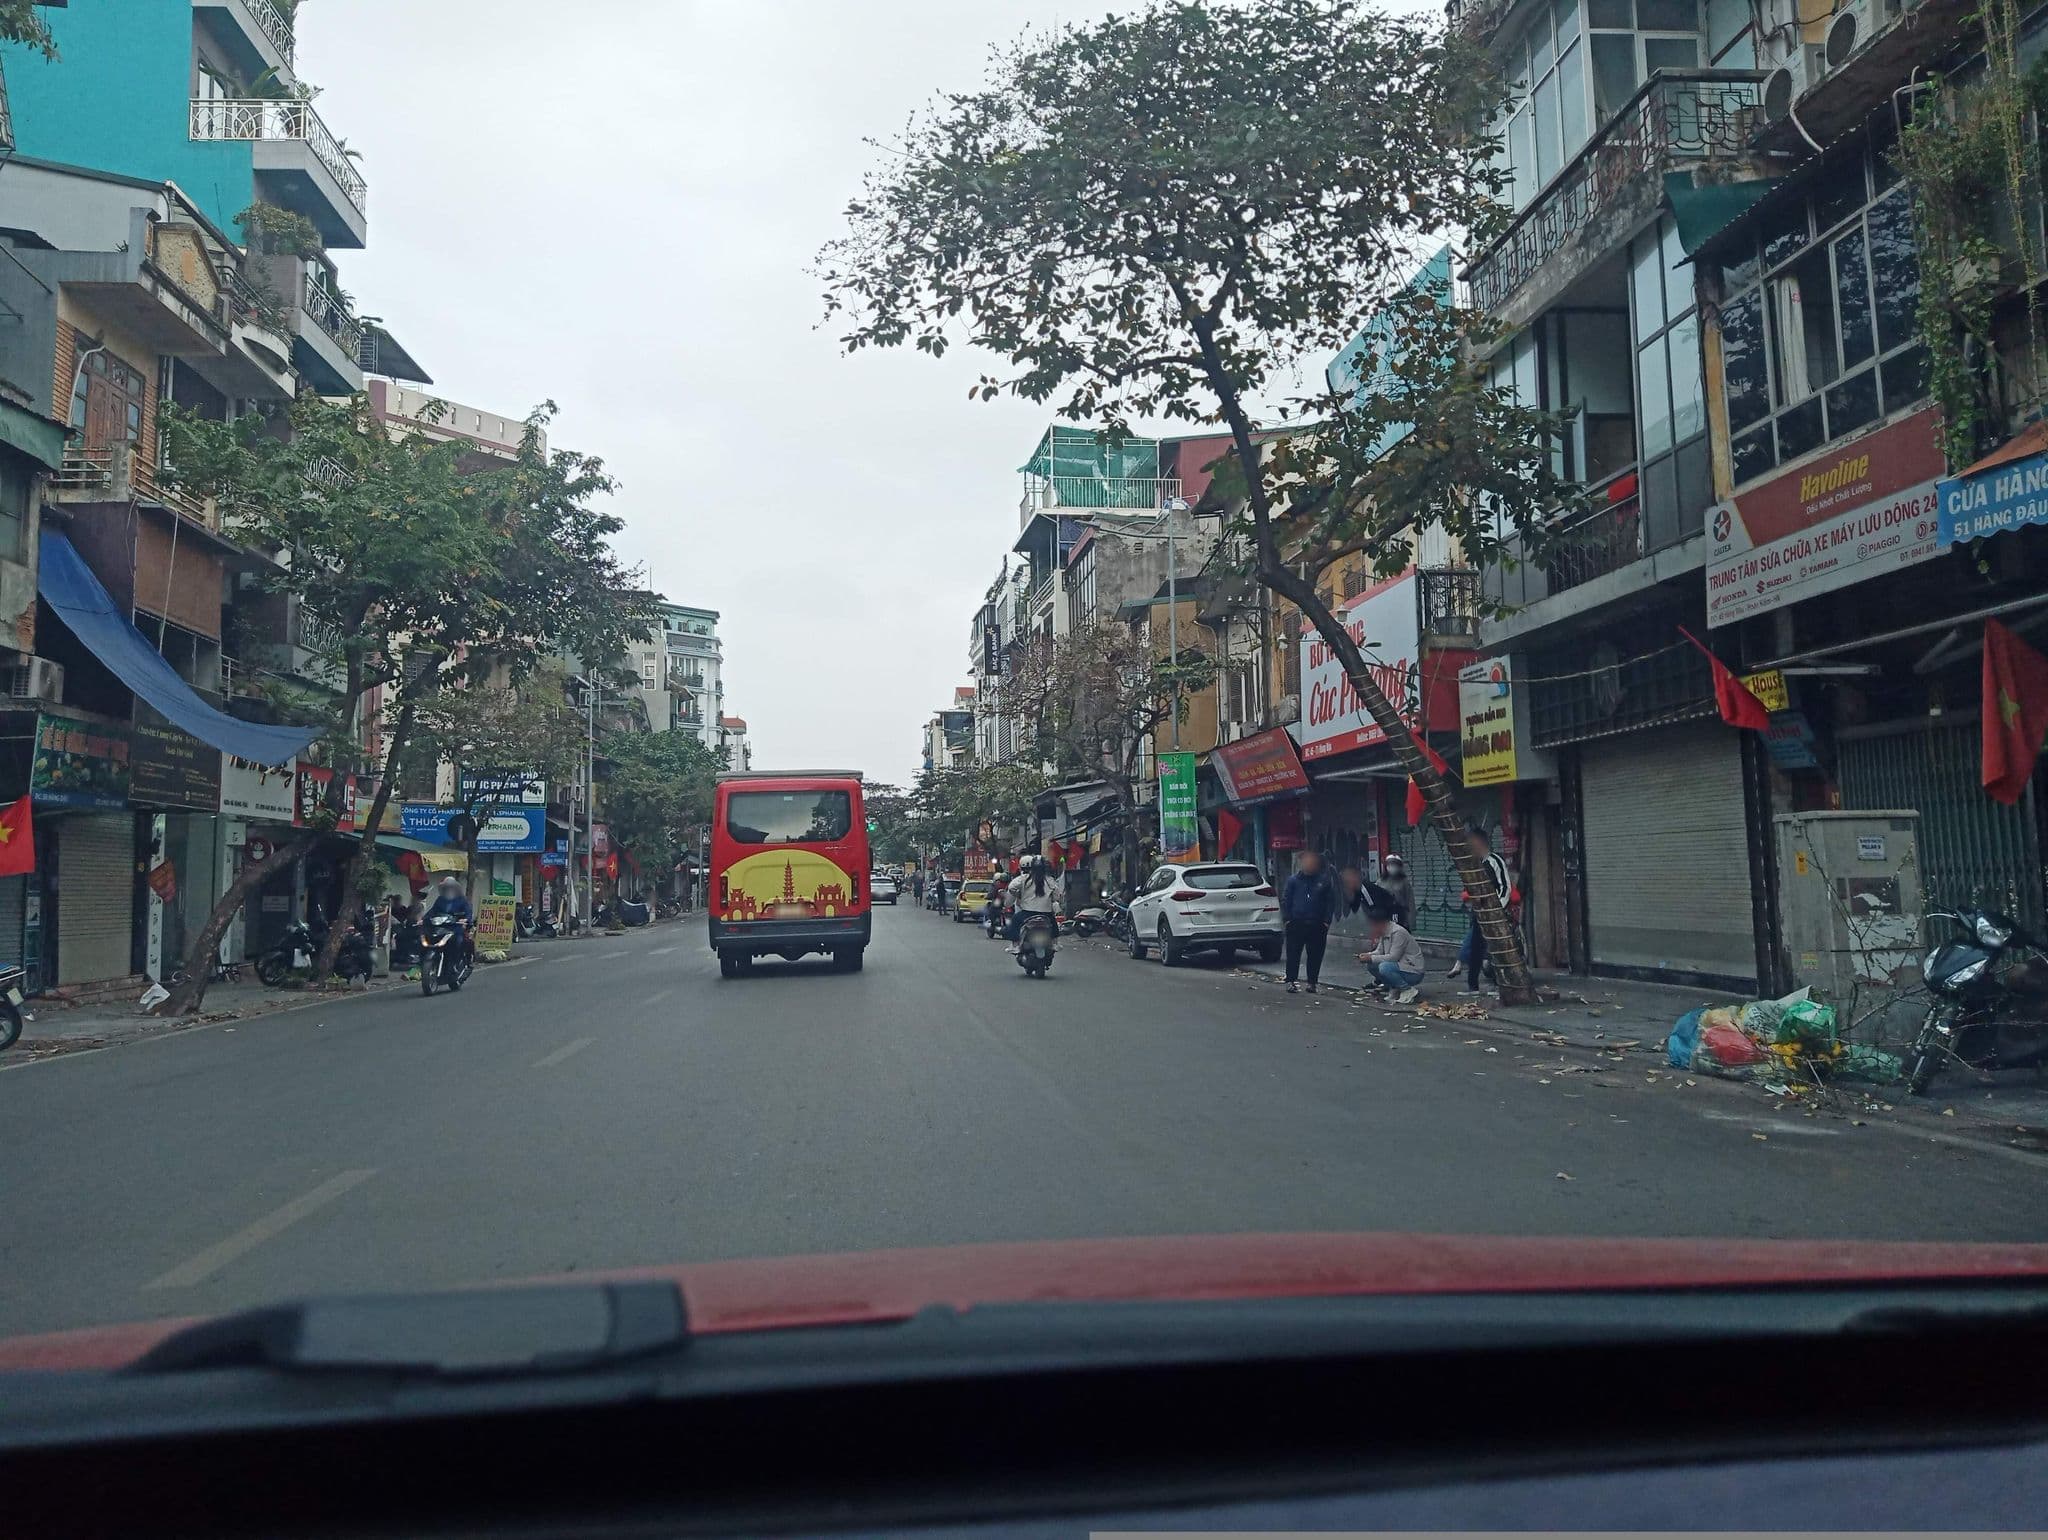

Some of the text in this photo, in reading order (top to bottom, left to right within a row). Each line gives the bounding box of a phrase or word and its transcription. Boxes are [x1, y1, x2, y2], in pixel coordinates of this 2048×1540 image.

[1800, 454, 1869, 503] Havoline
[1948, 480, 1988, 515] CỬA
[1954, 519, 1970, 537] 51
[1974, 508, 2012, 533] HÀNG
[1709, 567, 1737, 592] TRUNG
[1738, 559, 1759, 581] TÂM
[1760, 547, 1782, 573] SỬA
[1783, 538, 1812, 565] CHỮA
[1814, 533, 1828, 553] XE
[1830, 520, 1855, 548] MÁY
[1858, 512, 1881, 537] LƯU
[1884, 499, 1920, 528] ĐỘNG
[1713, 543, 1732, 557] CALTEX
[1722, 589, 1748, 604] HONDA
[1766, 573, 1792, 589] SUZUKI
[1808, 558, 1839, 575] YAMAHA
[1868, 534, 1901, 553] PIAGGIO
[1310, 673, 1338, 727] Cúc
[1752, 673, 1784, 694] HOUSE
[409, 814, 446, 827] THUỐC
